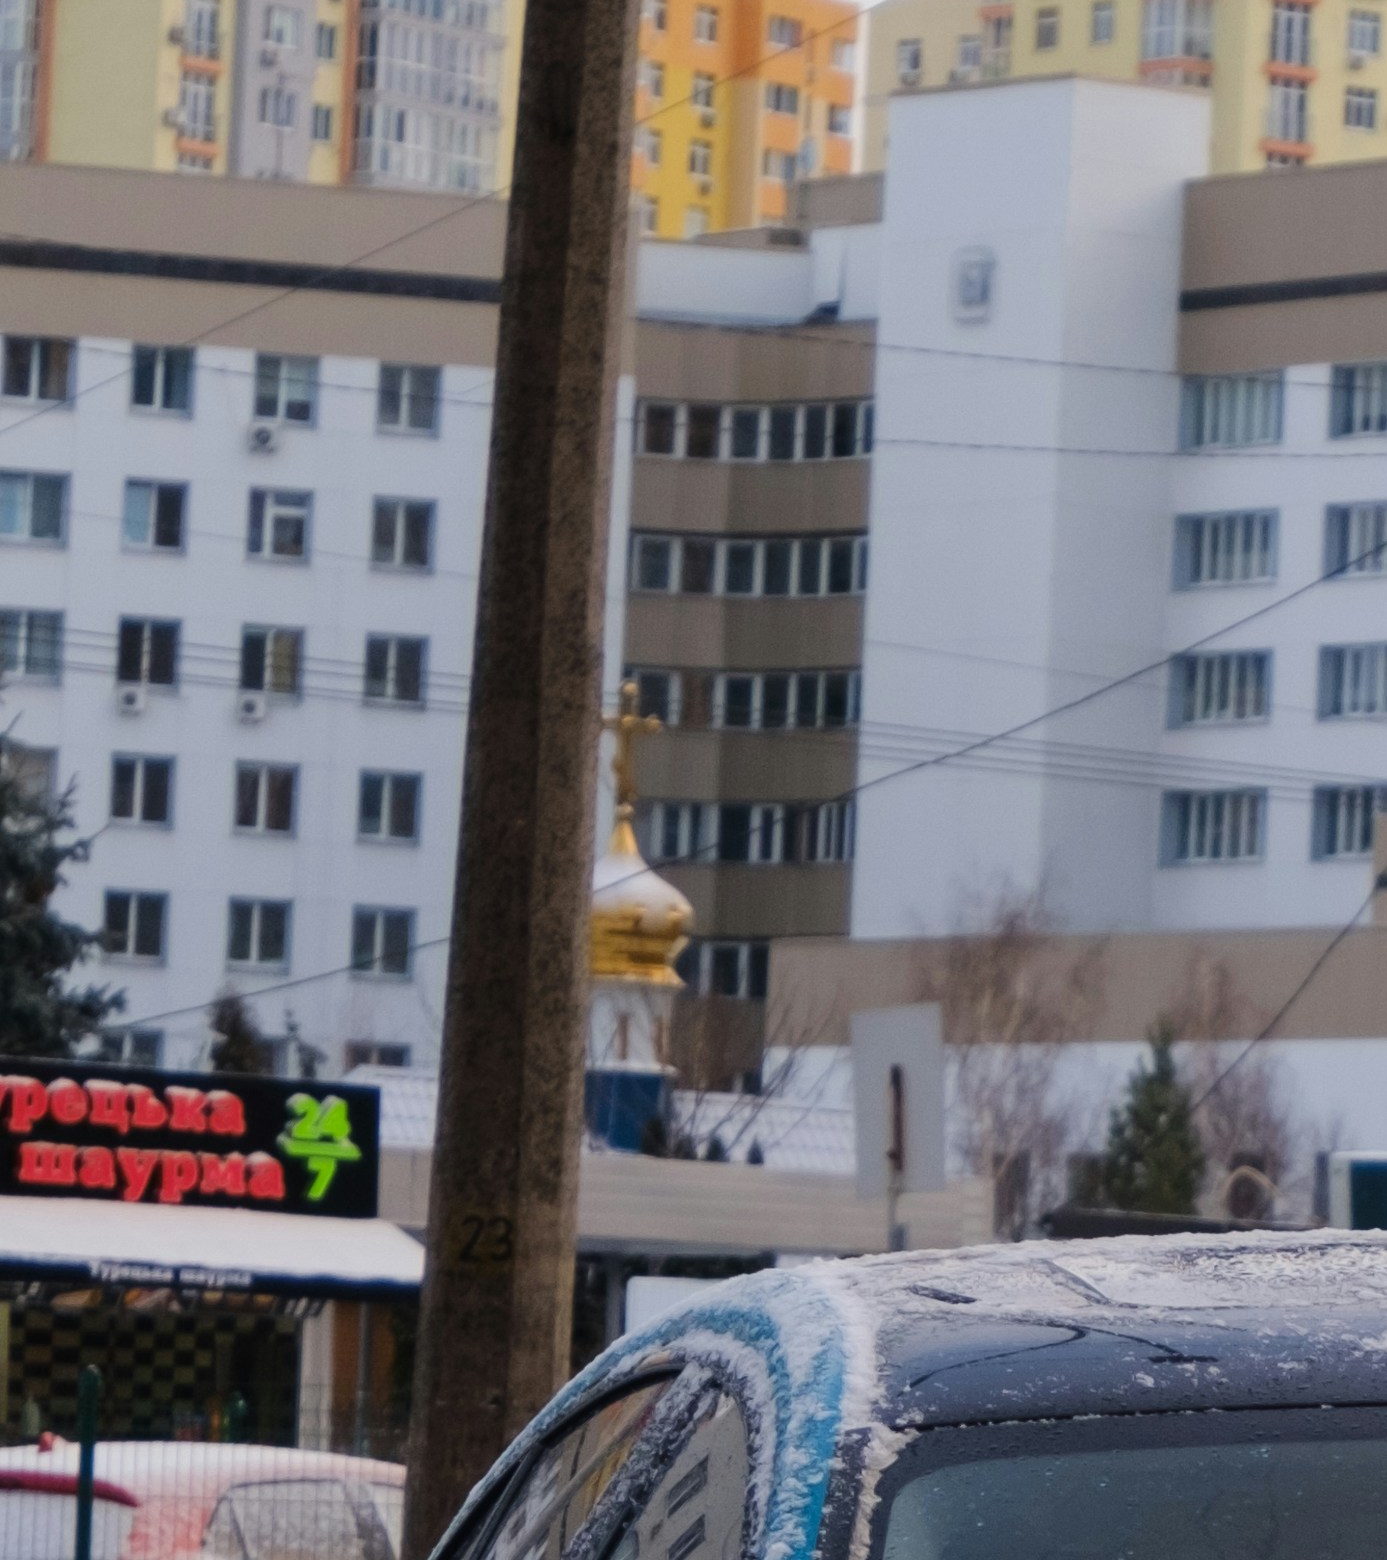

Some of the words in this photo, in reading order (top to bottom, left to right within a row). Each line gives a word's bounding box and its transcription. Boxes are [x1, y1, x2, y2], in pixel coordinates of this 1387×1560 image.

[285, 1092, 351, 1140] 24
[19, 1141, 286, 1203] шаурма
[459, 1214, 514, 1263] 23
